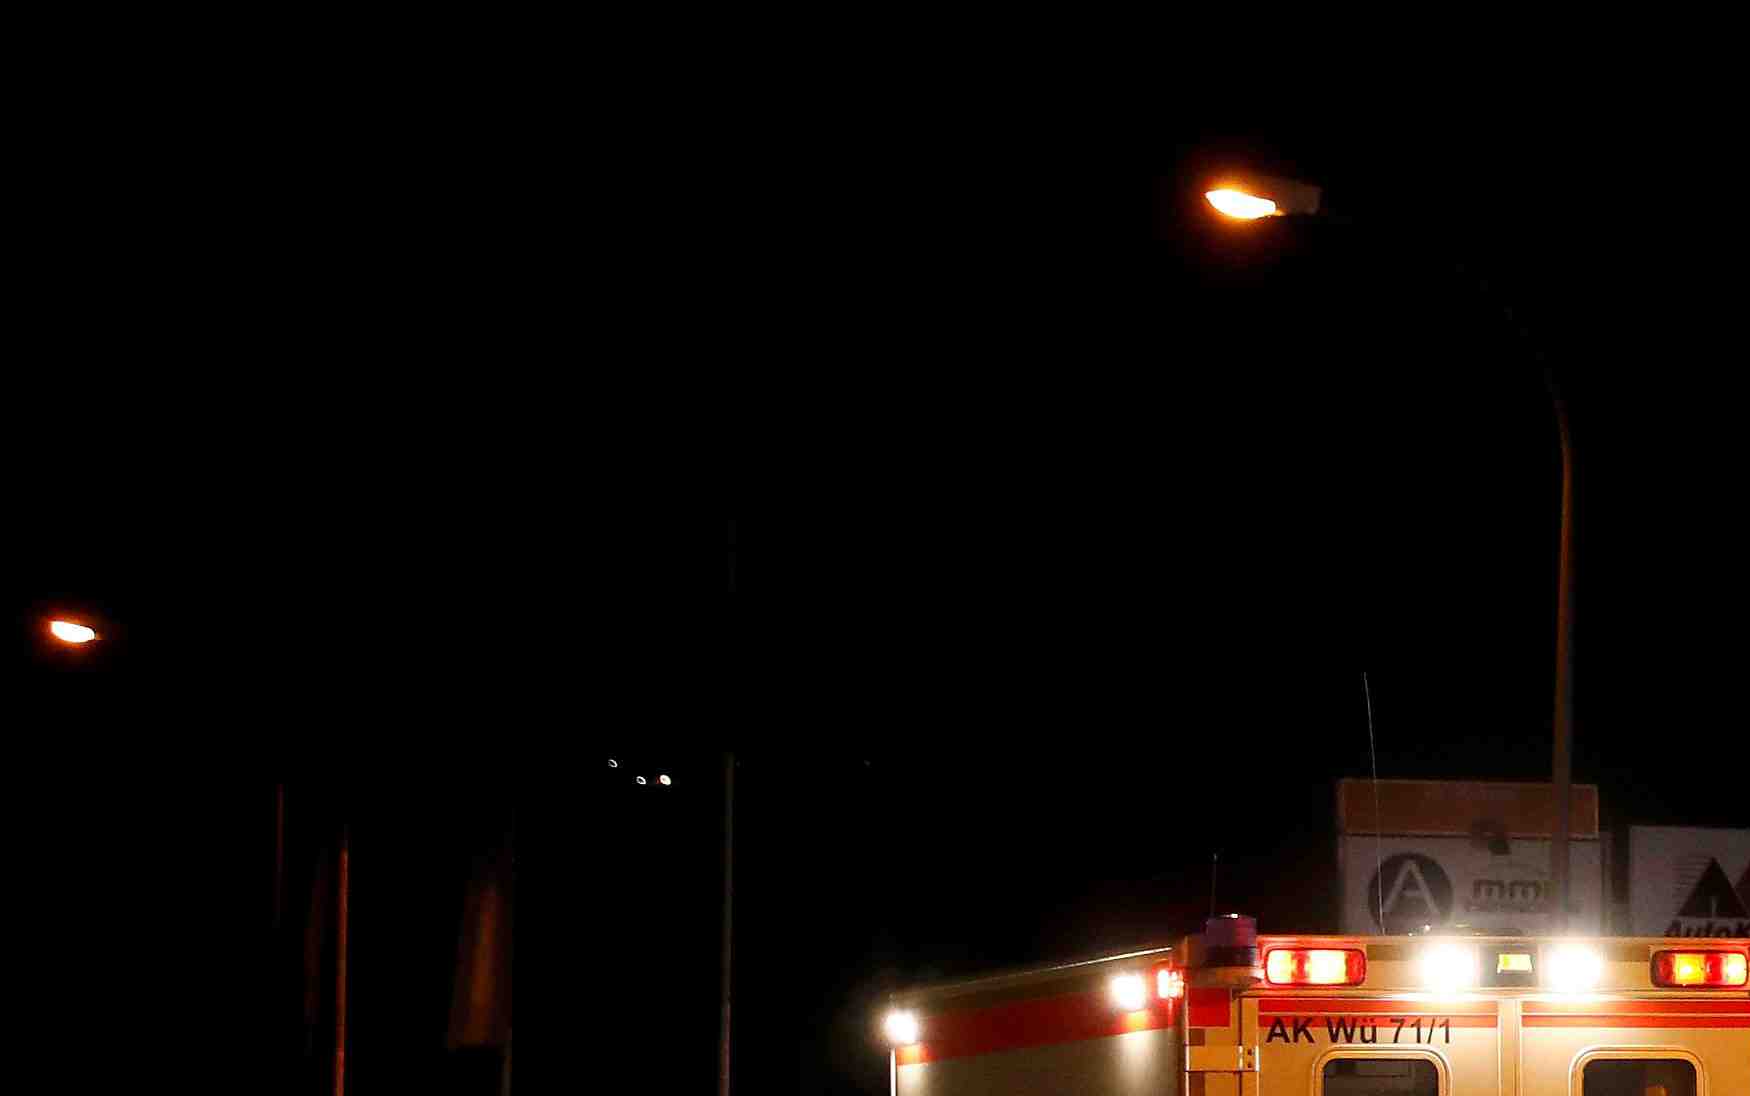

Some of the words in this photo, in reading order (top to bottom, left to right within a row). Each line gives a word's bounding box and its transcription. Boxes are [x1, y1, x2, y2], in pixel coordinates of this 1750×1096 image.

[1266, 1018, 1315, 1044] AK
[1327, 1018, 1377, 1044] Wü
[1391, 1017, 1451, 1044] 71/1
